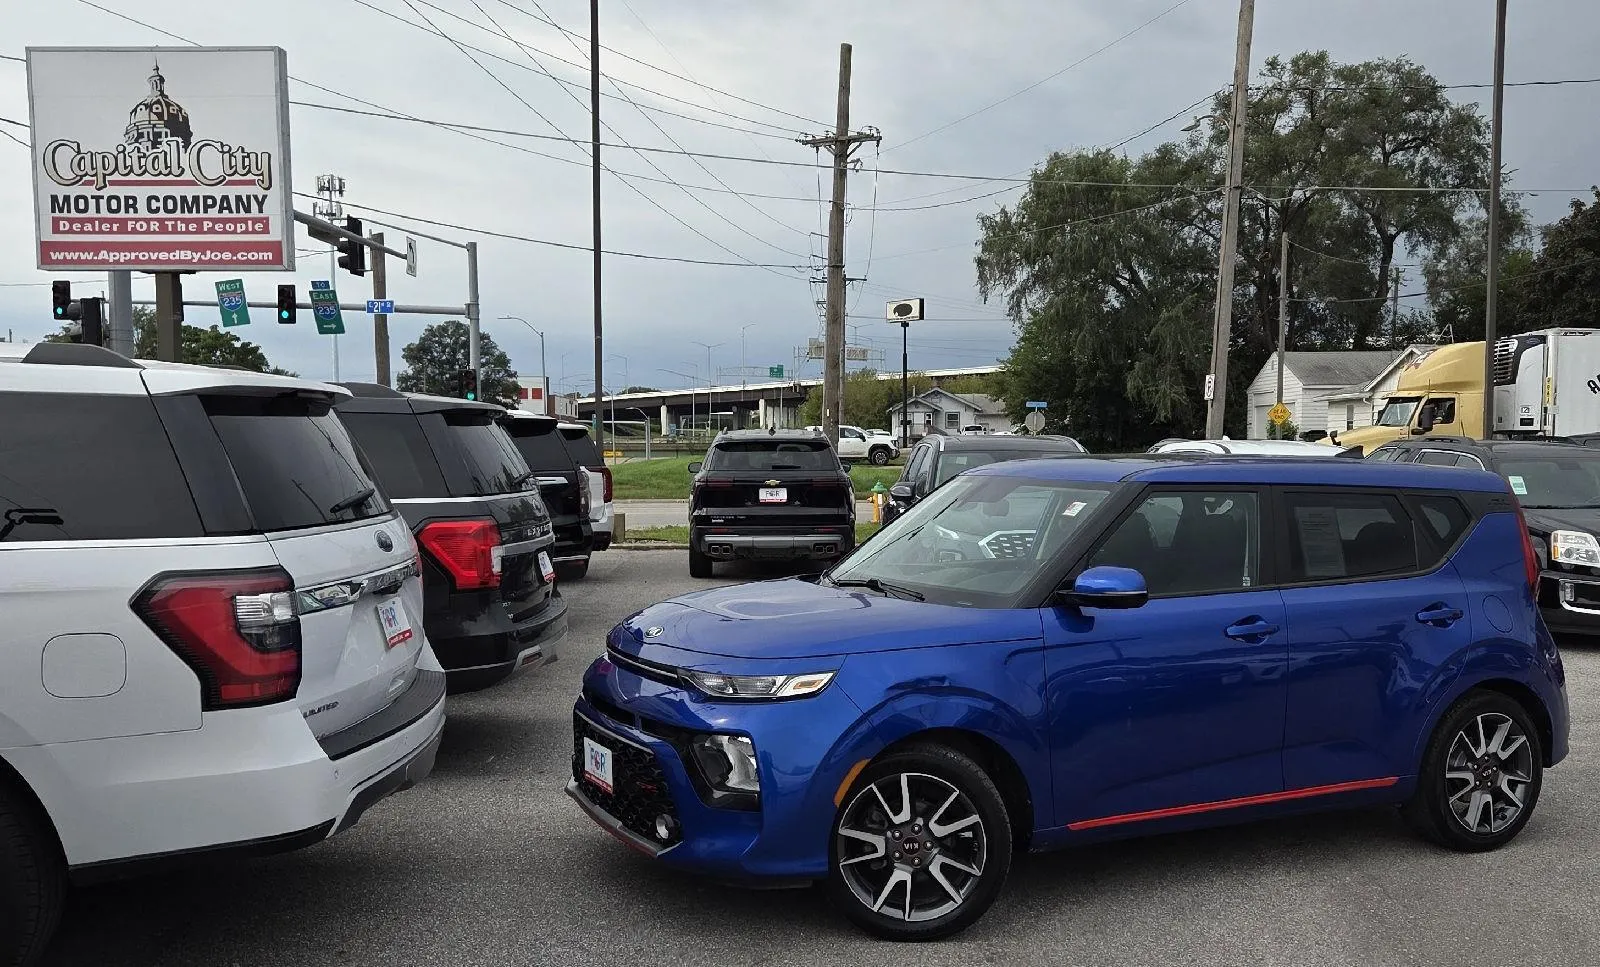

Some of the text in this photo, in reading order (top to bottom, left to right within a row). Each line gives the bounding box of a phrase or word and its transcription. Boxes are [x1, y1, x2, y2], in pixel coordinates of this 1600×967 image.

[43, 139, 272, 191] Capital City
[50, 194, 268, 215] MOTOR COMPANY
[59, 220, 264, 234] Dealer FOR The People
[50, 249, 273, 264] www.ApprovedByJoe.com
[224, 297, 241, 306] 235
[317, 305, 335, 315] 235
